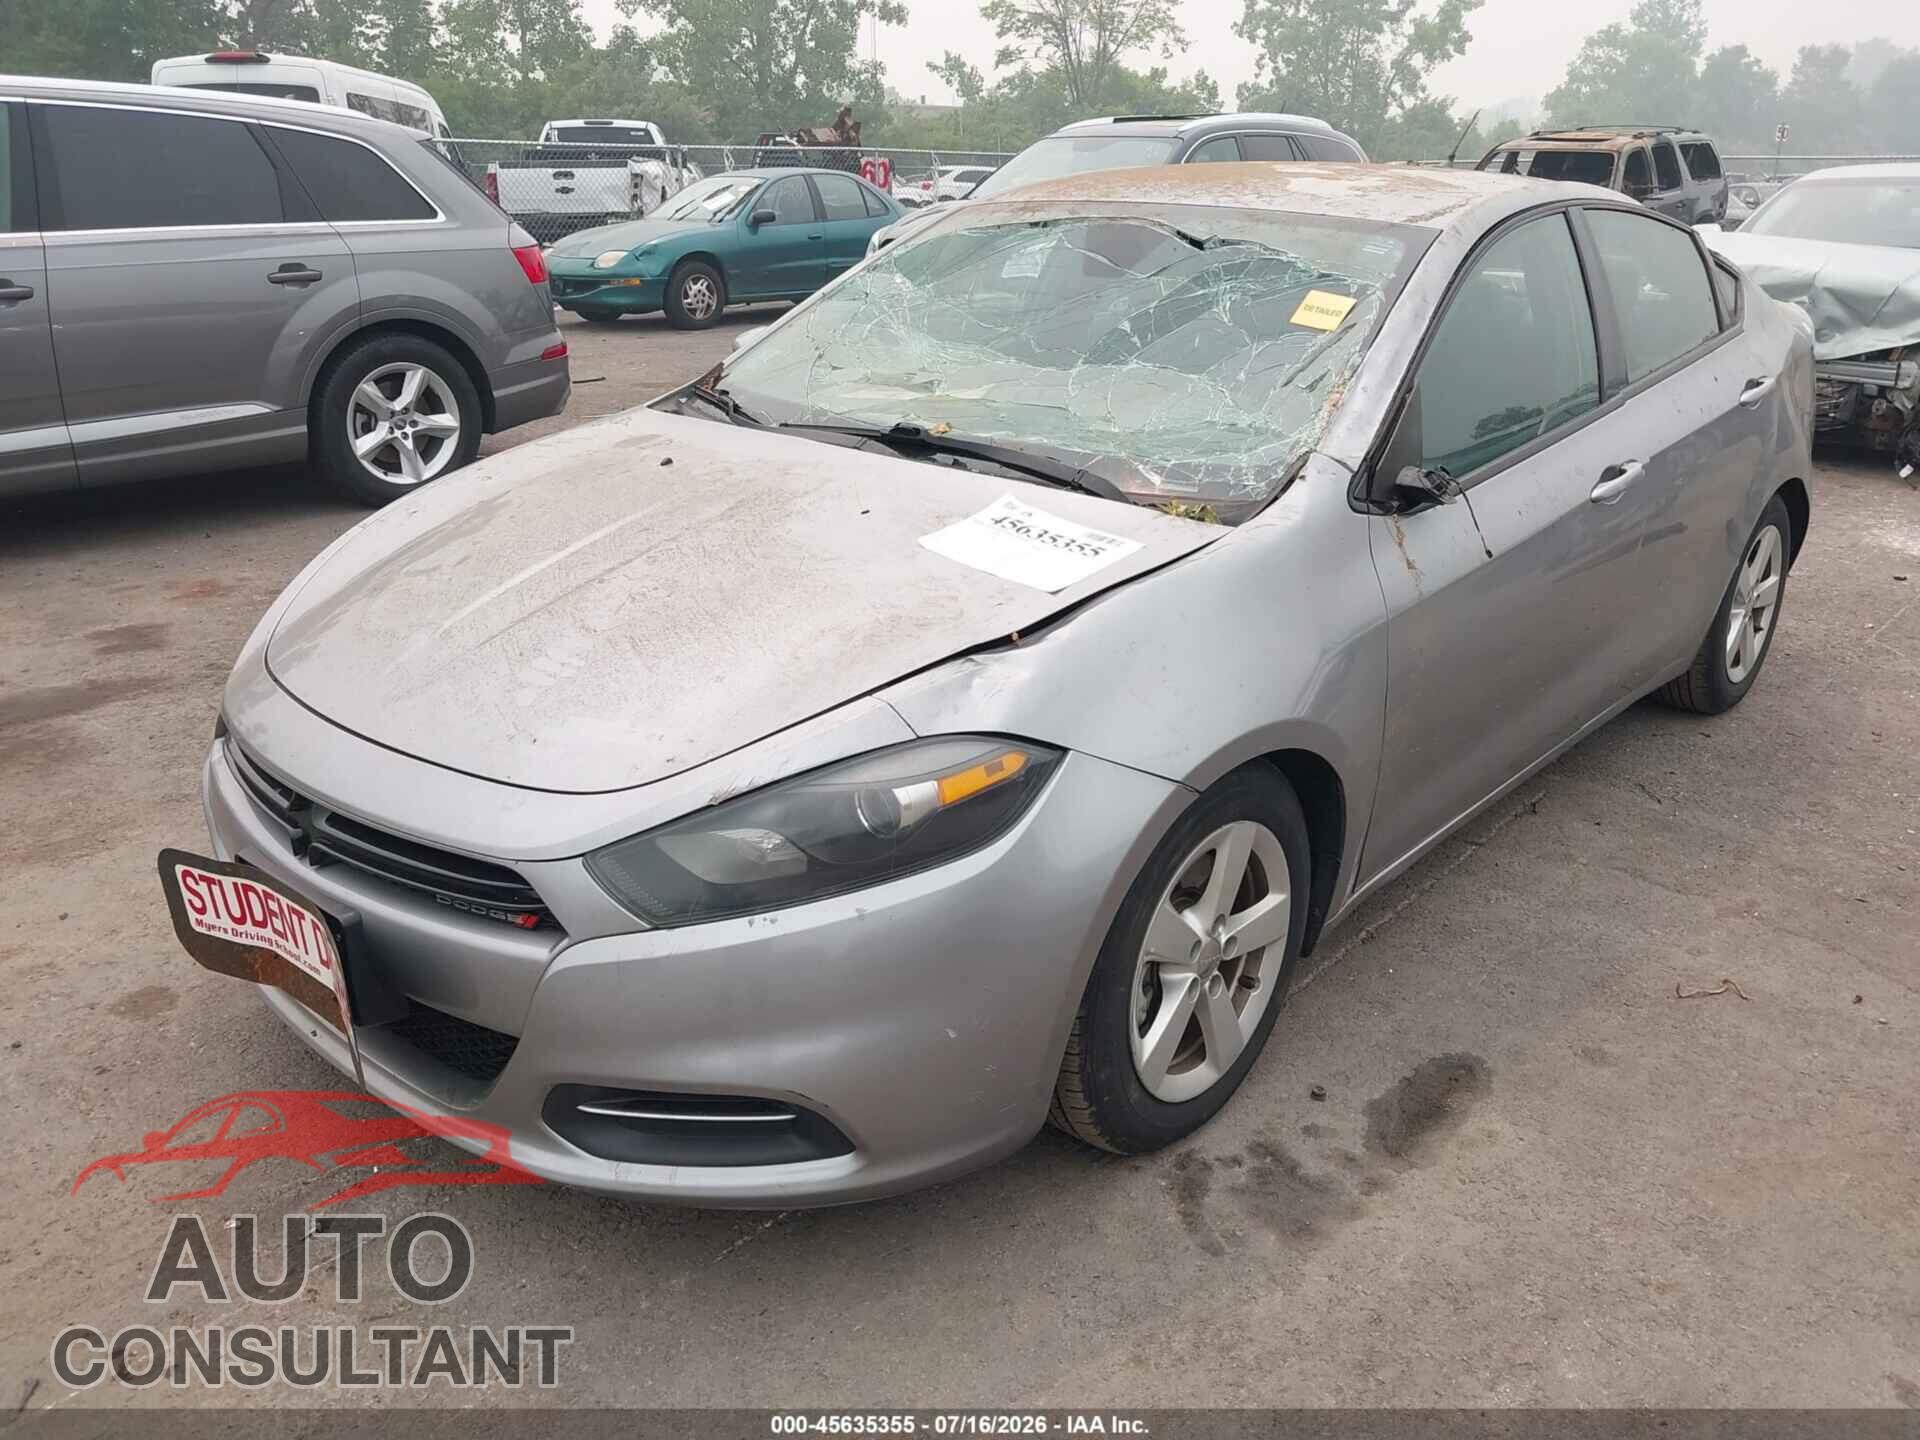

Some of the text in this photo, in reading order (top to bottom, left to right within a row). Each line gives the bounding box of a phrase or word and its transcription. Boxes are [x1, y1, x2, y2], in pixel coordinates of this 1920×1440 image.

[862, 159, 890, 189] 60
[990, 515, 1107, 558] 45635355
[181, 869, 309, 956] STUDENT
[435, 894, 518, 923] DODGE
[194, 917, 229, 934] Myers
[231, 927, 273, 947] Driving
